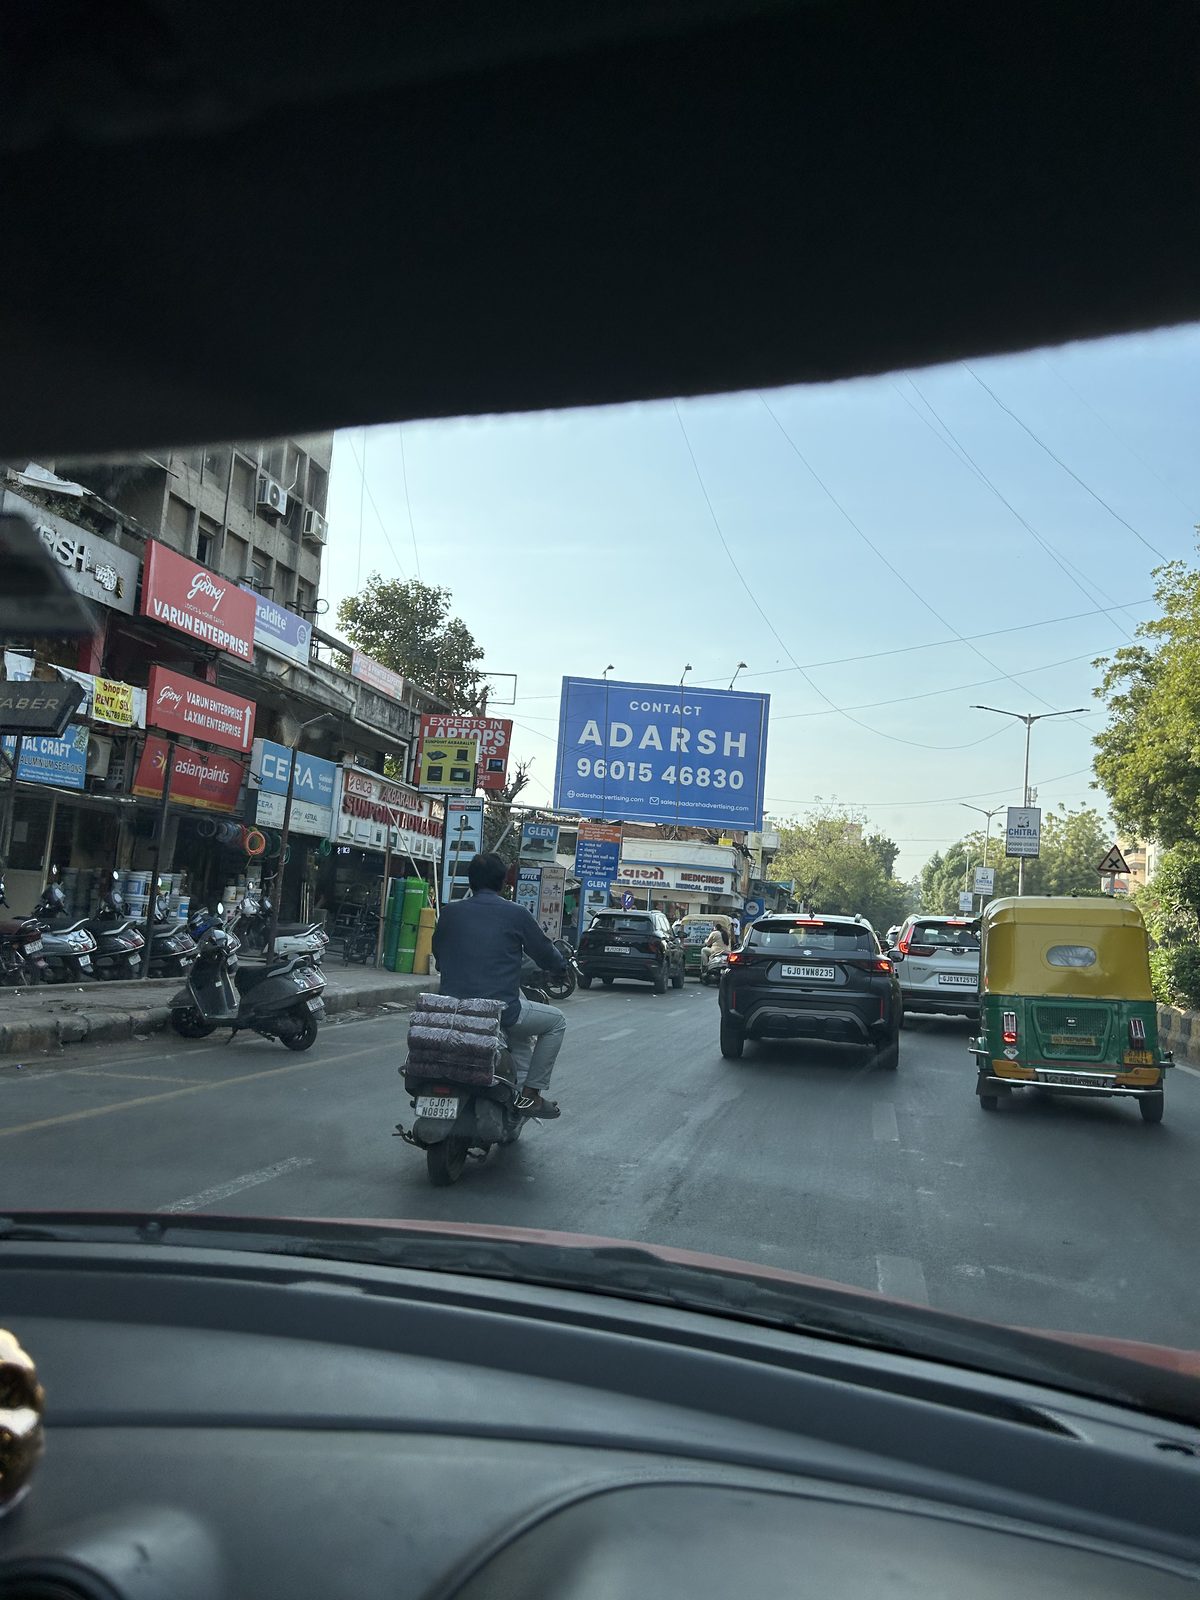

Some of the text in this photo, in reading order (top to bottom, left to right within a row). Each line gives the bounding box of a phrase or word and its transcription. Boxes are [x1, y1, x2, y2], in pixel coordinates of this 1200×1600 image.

[33, 522, 87, 573] RISH
[187, 572, 226, 612] Godrej
[256, 603, 288, 630] raldite
[153, 598, 192, 631] VARUN
[194, 618, 249, 657] ENTERPRISE
[0, 697, 59, 710] ABER
[95, 693, 115, 708] RENT
[186, 691, 210, 710] VARUN
[209, 701, 243, 721] ENTERPRISE
[629, 701, 702, 716] CONTACT
[183, 709, 242, 738] LAXMI ENTERPRISE
[429, 717, 503, 730] EXPERTS IN
[577, 720, 747, 758] ADARSH
[40, 738, 72, 758] CRAFT
[54, 760, 83, 775] SECTIONS
[175, 759, 230, 784] asianpaints
[261, 753, 314, 790] CERA
[577, 757, 745, 790] 96015 46830
[400, 813, 444, 841] NOVELTIE
[528, 826, 555, 837] GLEN
[1008, 828, 1038, 836] CHITRA
[587, 880, 607, 888] GLEN
[631, 879, 671, 888] CHAMUNDA
[680, 872, 725, 885] MEDICINES
[675, 882, 703, 891] MEDICAL
[786, 965, 834, 978] GJ01WN8235
[429, 1097, 452, 1107] GJ01
